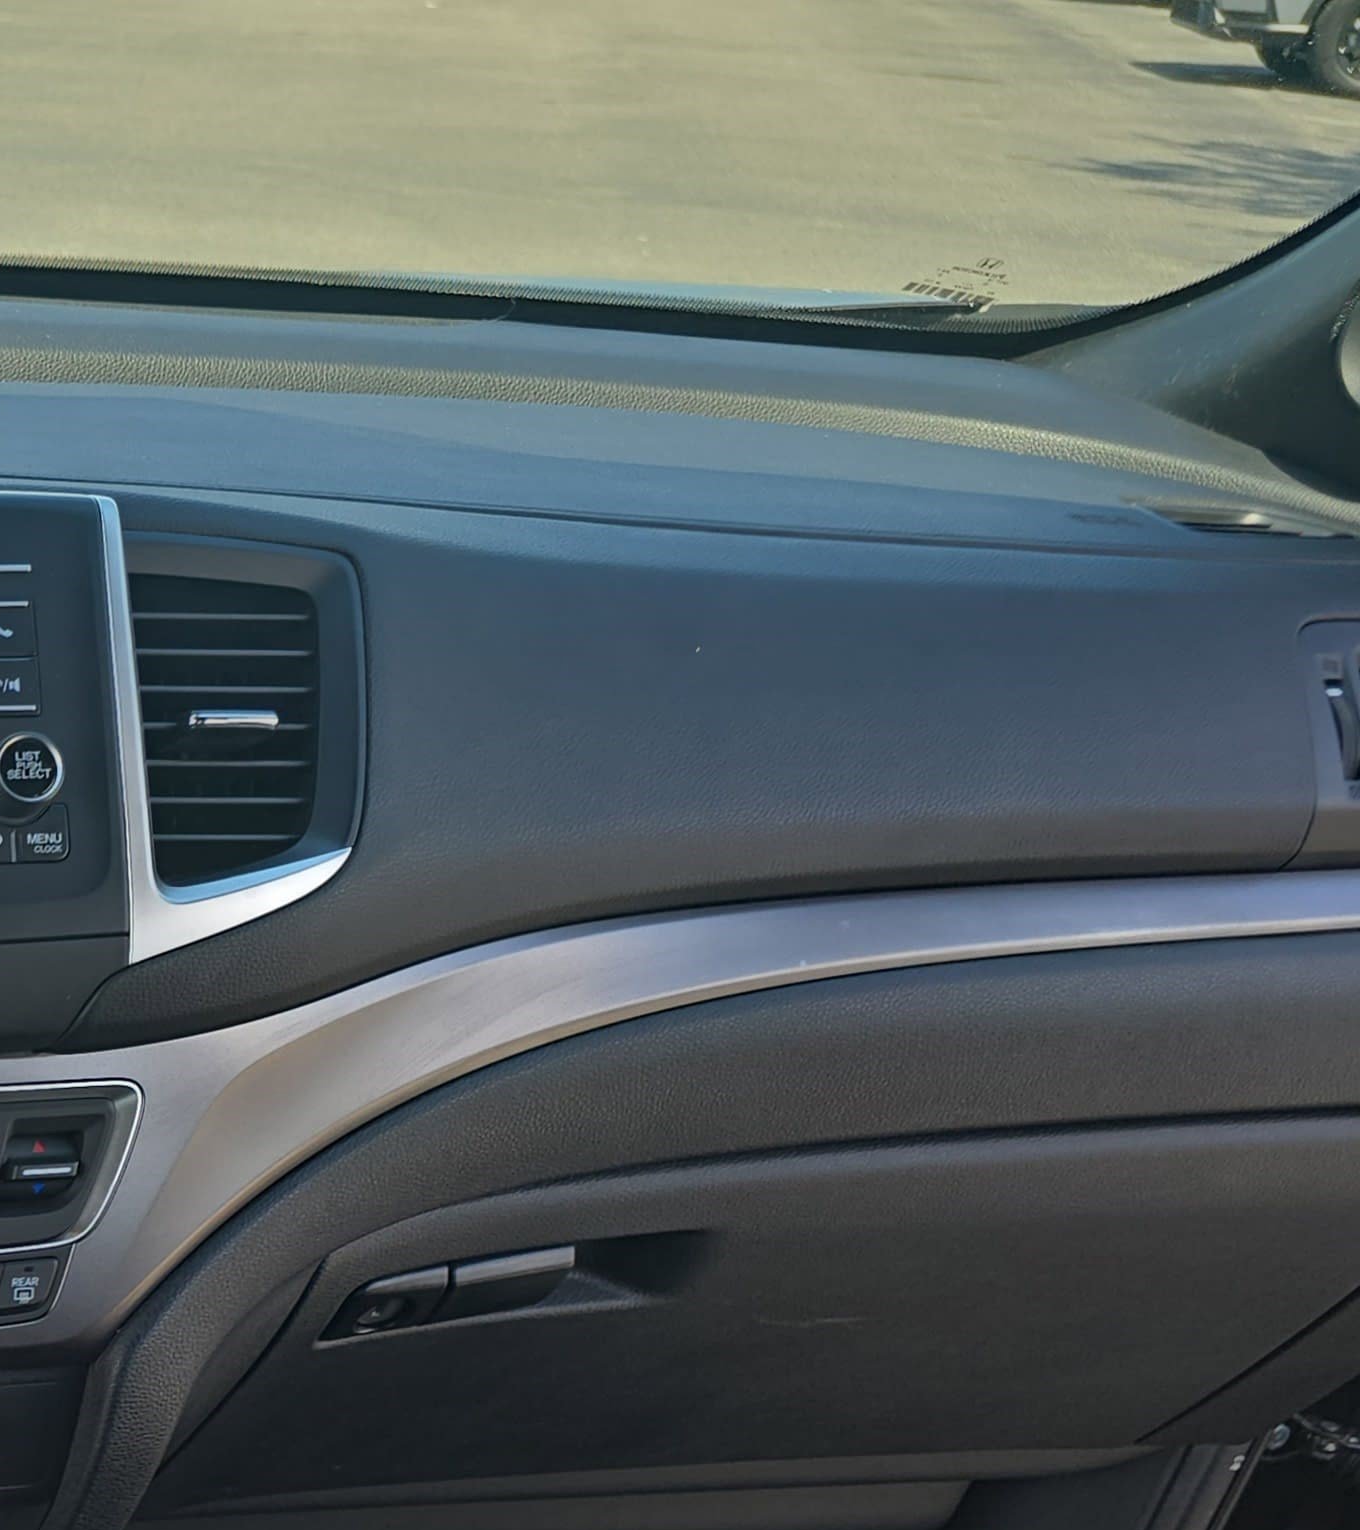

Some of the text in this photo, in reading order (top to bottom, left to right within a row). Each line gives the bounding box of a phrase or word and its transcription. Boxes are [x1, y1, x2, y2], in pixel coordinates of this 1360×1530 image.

[14, 751, 41, 761] LIST
[6, 768, 52, 780] SELECT
[26, 832, 63, 845] MENU
[33, 844, 63, 854] CLOCK
[11, 1276, 39, 1287] REAR
